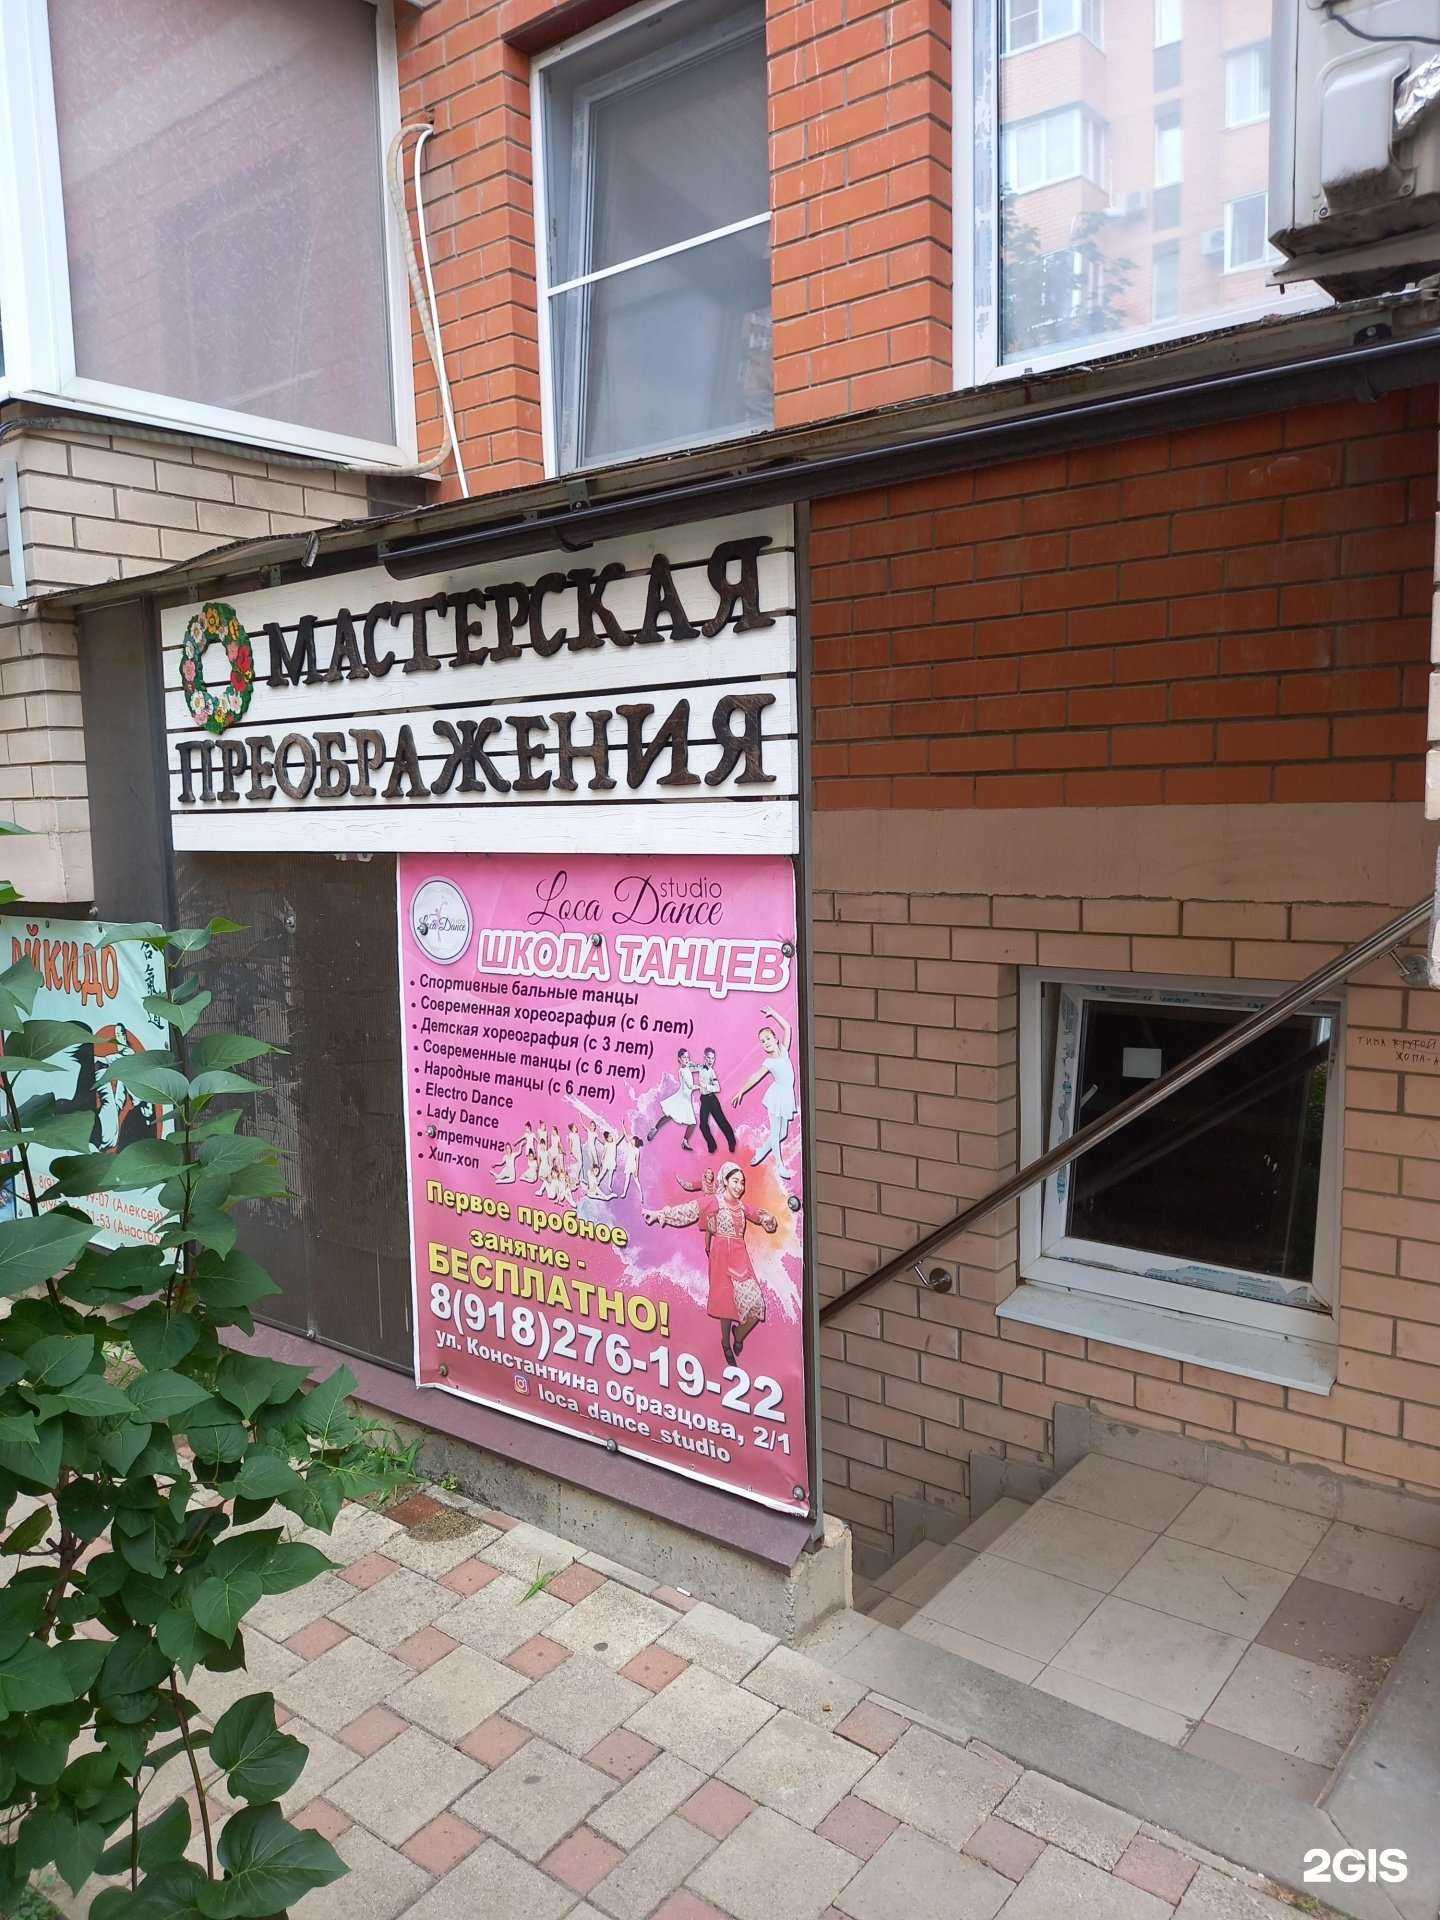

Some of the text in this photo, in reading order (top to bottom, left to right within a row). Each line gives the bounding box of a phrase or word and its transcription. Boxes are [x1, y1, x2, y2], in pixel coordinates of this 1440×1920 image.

[263, 535, 776, 687] МАСТЕРСКАЯ
[174, 692, 778, 803] ПРЕОБРАЖЕНИЯ
[526, 870, 723, 933] Loca Dance
[660, 877, 722, 898] studio
[480, 932, 787, 994] ШКОЛА ТАНЦЕВ
[420, 974, 639, 1007] Спортивные бальные танцы
[420, 1017, 654, 1060] Детская хореография (с 3 лет)
[421, 995, 694, 1039] Современная хореография (с 6 лет)
[423, 1039, 646, 1084] Современные танцы (с 6 лет)
[424, 1060, 615, 1104] Народные танцы (с 6 лет)
[425, 1081, 513, 1108] Electro Dance
[427, 1103, 499, 1129] Lady Dance
[428, 1146, 480, 1169] Хип-хоп
[426, 1180, 628, 1248] Первое пробное
[469, 1229, 570, 1269] занятие
[428, 1241, 670, 1337] БЕСПЛАТНО!
[429, 1282, 786, 1423] 8(918)276-19-22
[435, 1329, 791, 1455] ул. Константина Образцова, 2/1
